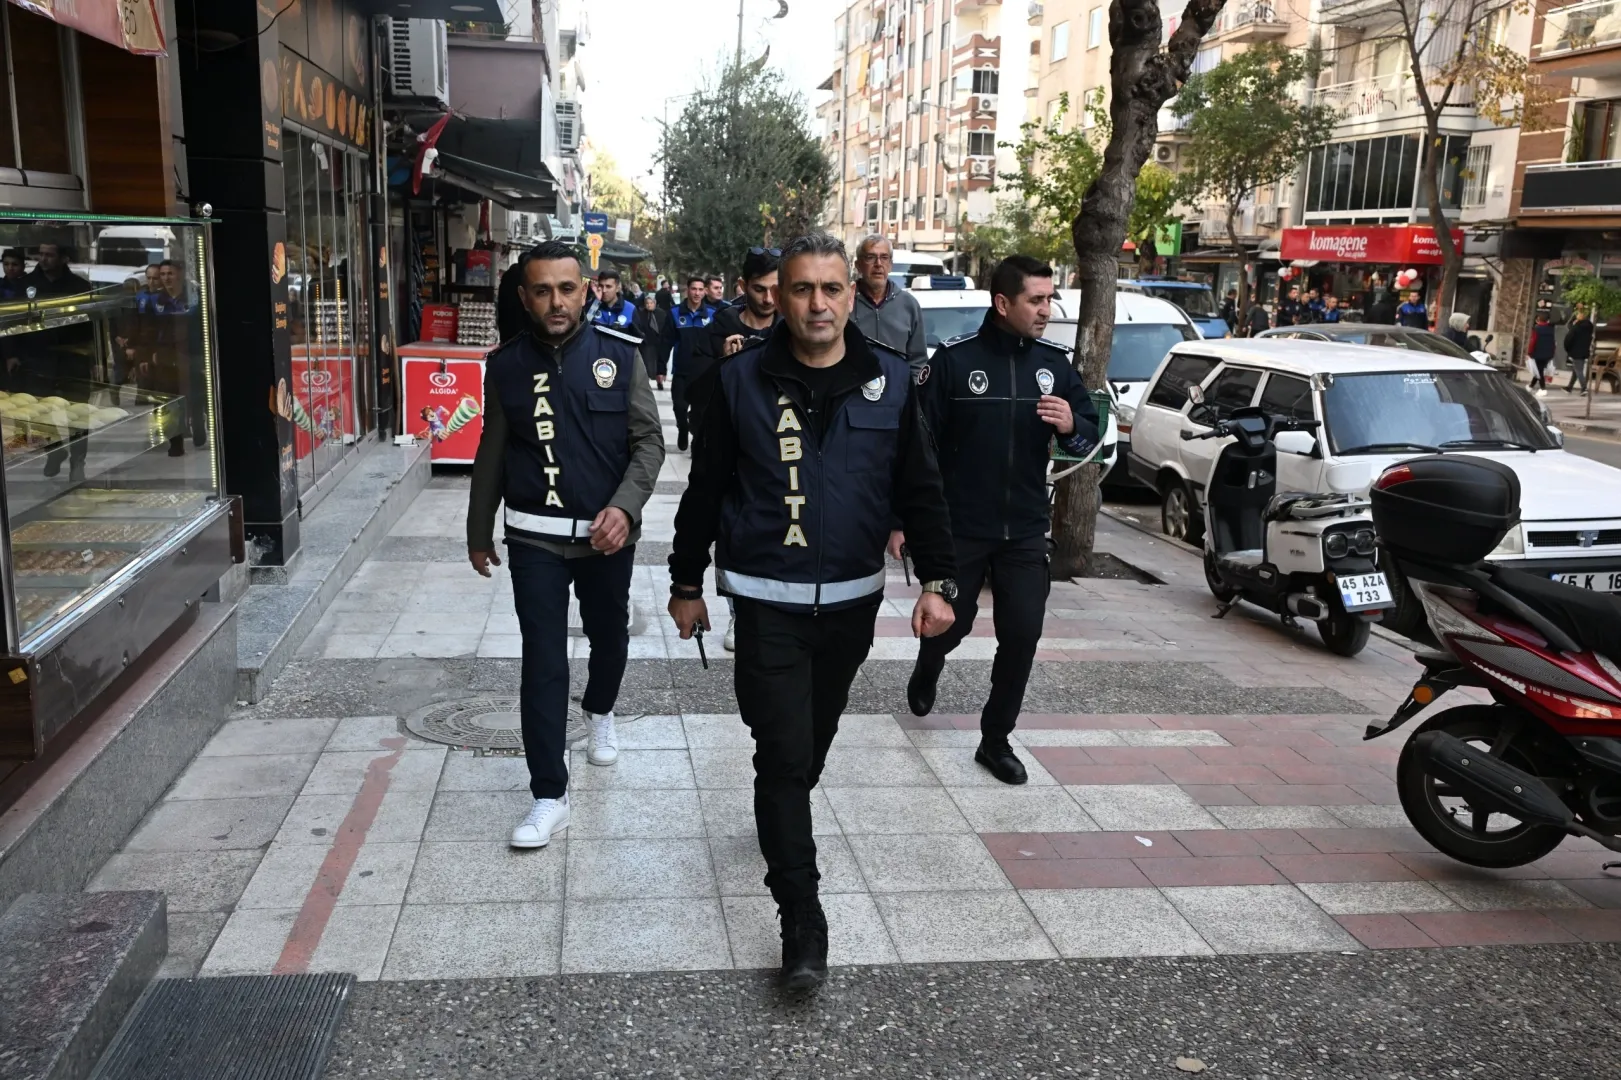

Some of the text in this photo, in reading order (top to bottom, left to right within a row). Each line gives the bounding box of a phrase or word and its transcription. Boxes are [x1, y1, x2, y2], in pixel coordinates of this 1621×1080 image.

[1309, 230, 1368, 257] komagene
[533, 373, 564, 508] ZABITA
[1342, 575, 1385, 590] 45 AZA
[1584, 574, 1595, 590] K
[1356, 590, 1380, 603] 733
